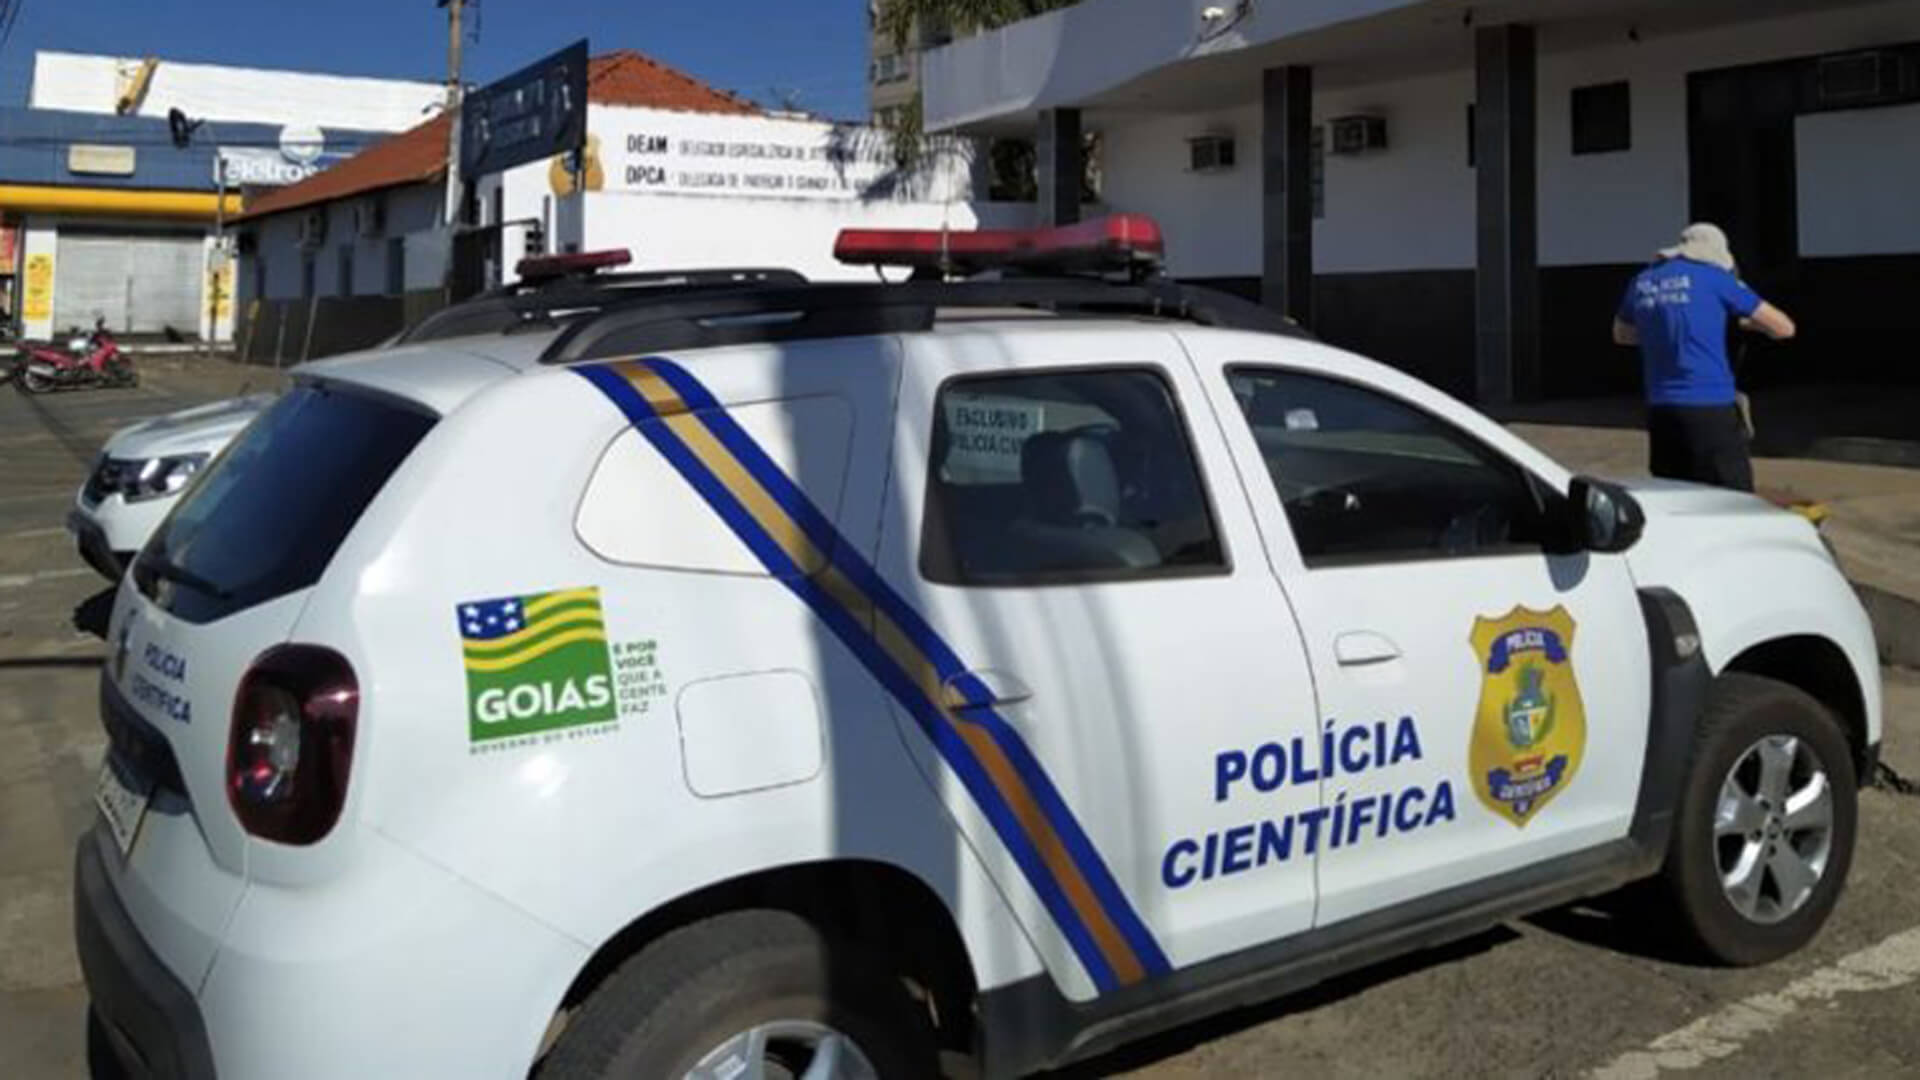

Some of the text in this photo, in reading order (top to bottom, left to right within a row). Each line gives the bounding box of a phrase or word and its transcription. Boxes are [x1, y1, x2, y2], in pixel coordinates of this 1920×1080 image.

[627, 134, 668, 154] DEAM
[625, 165, 665, 184] DPCA
[626, 640, 657, 653] POR
[618, 669, 662, 686] QUE A
[1214, 715, 1423, 803] POLÍCIA
[1161, 780, 1456, 889] CIENTÍFICA
